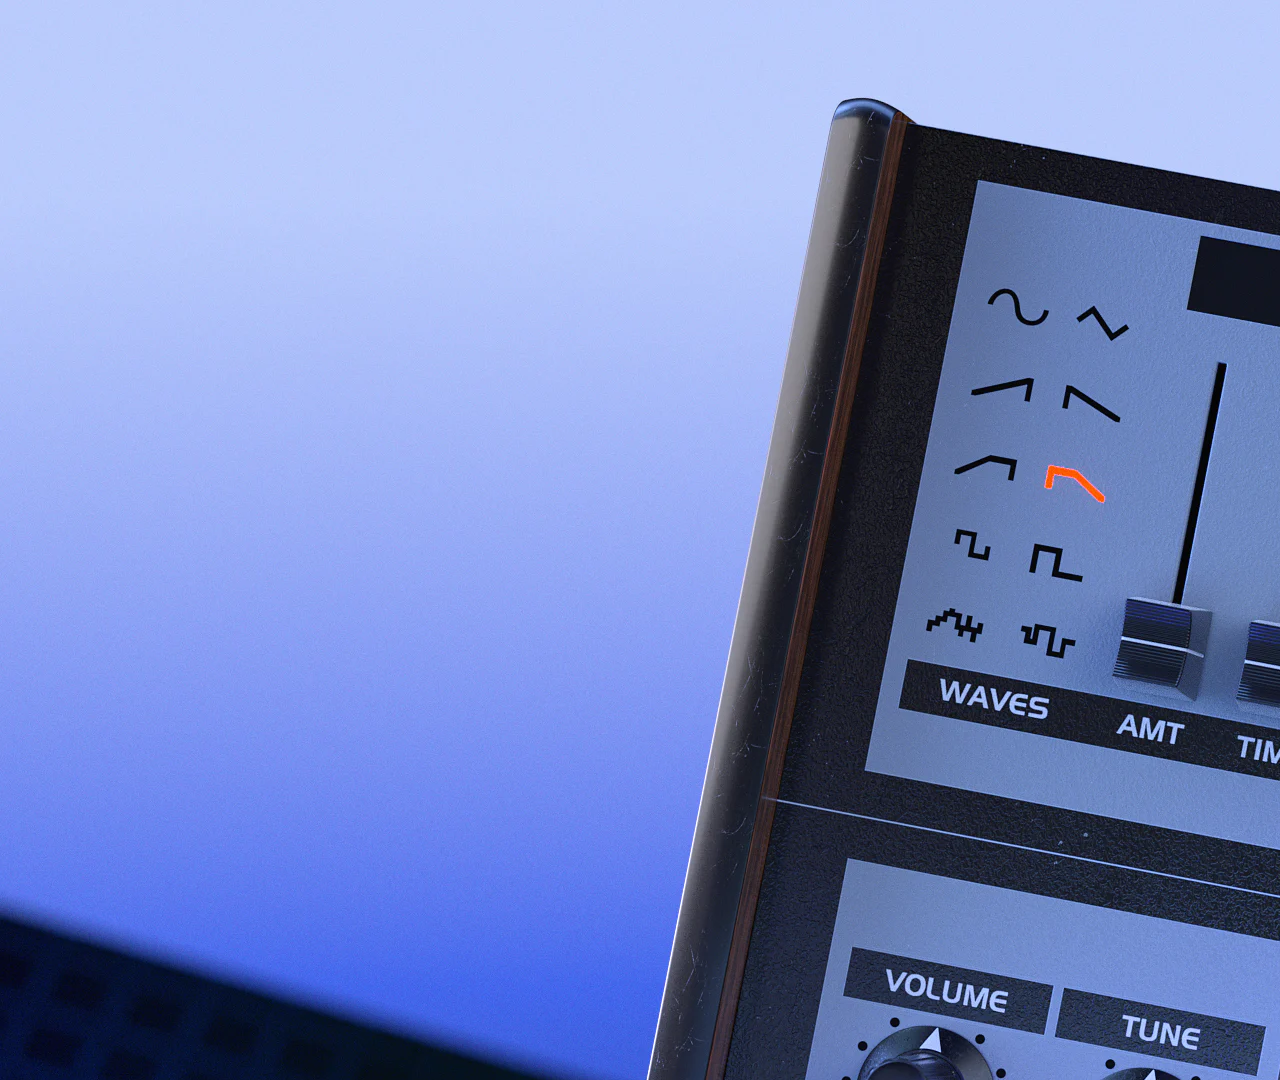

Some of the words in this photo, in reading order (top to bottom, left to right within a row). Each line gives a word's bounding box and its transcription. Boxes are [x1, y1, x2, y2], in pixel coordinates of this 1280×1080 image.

[939, 678, 1050, 720] WAVES
[1116, 713, 1186, 745] AMT
[885, 968, 1009, 1014] VOLUME
[1122, 1014, 1201, 1051] TUNE
